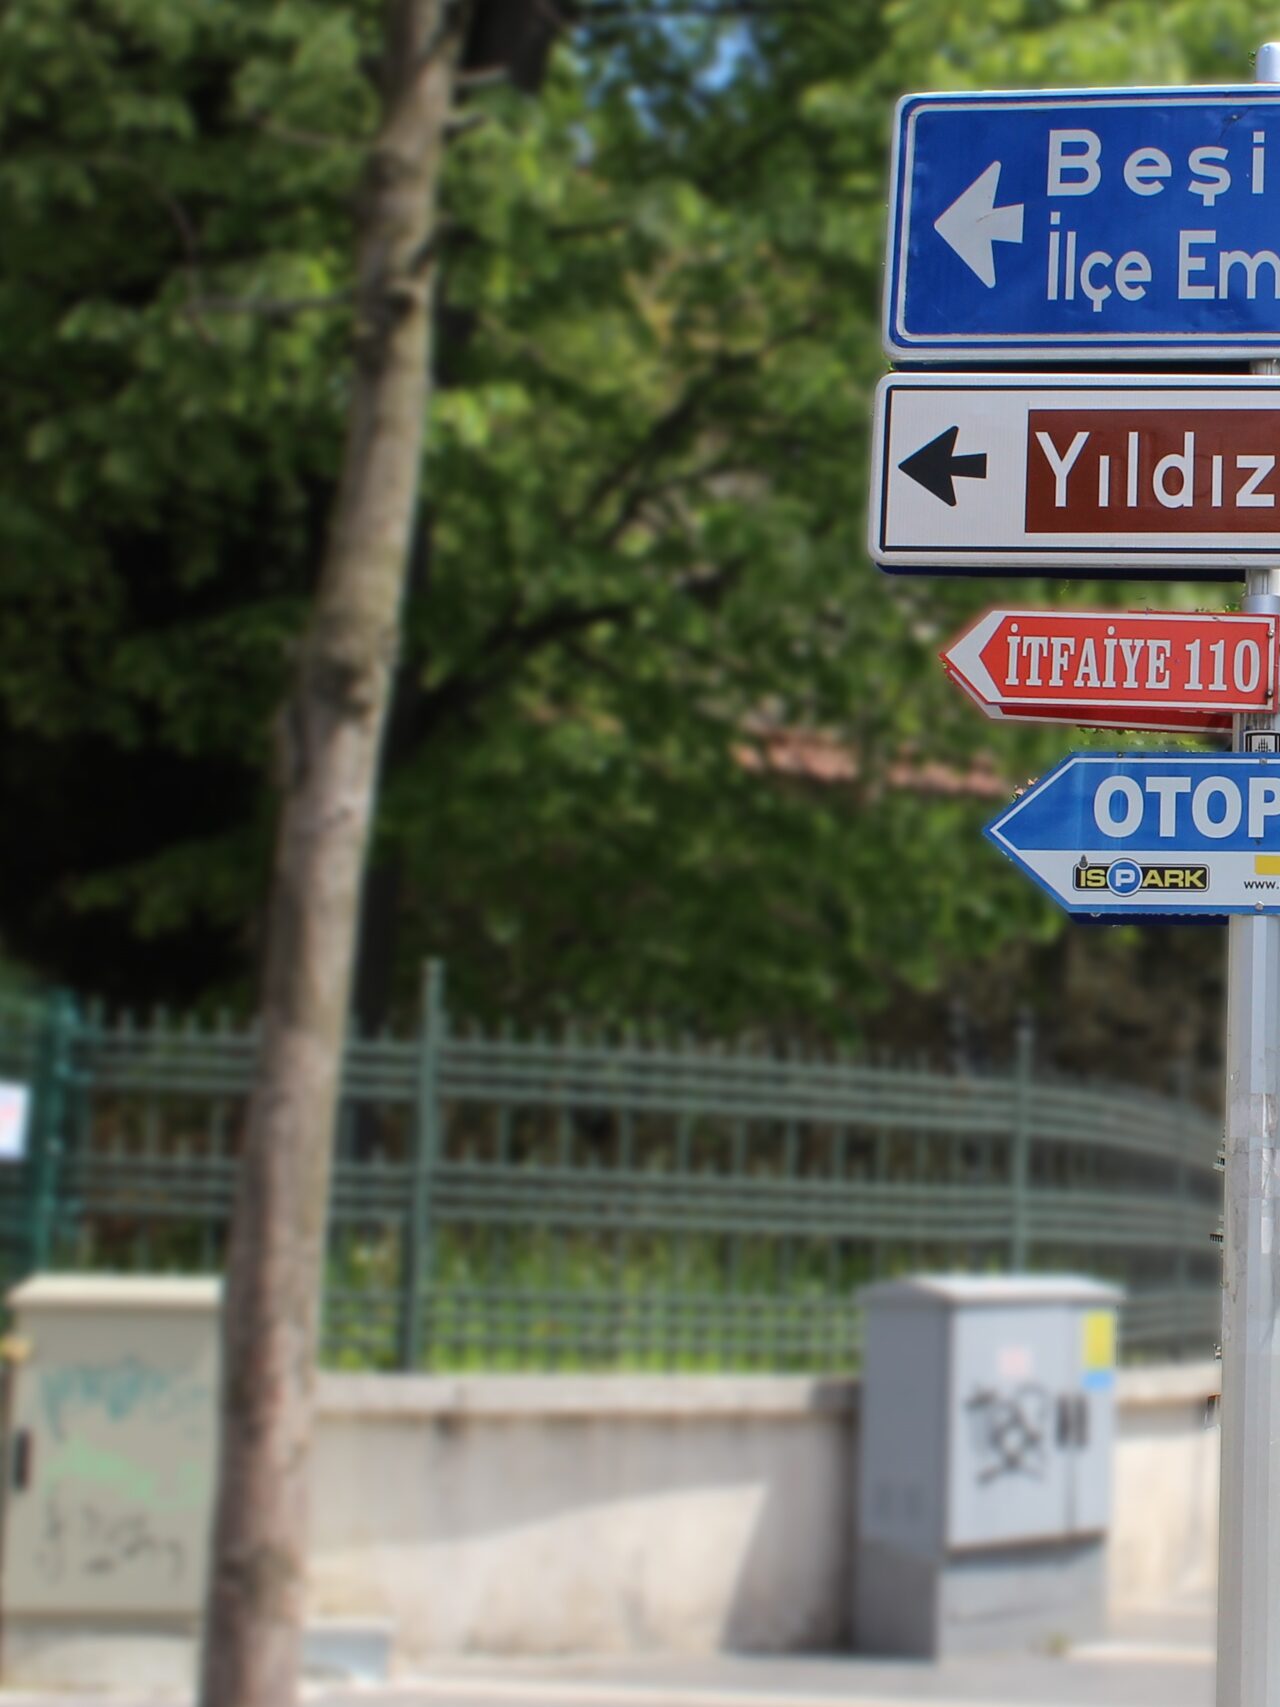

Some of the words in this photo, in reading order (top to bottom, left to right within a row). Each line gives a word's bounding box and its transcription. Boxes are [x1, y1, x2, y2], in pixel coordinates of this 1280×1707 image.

[1047, 211, 1152, 313] İlçe
[1036, 431, 1276, 509] Yıldız
[1005, 623, 1171, 690] İTFAİYE
[1184, 639, 1260, 693] 110
